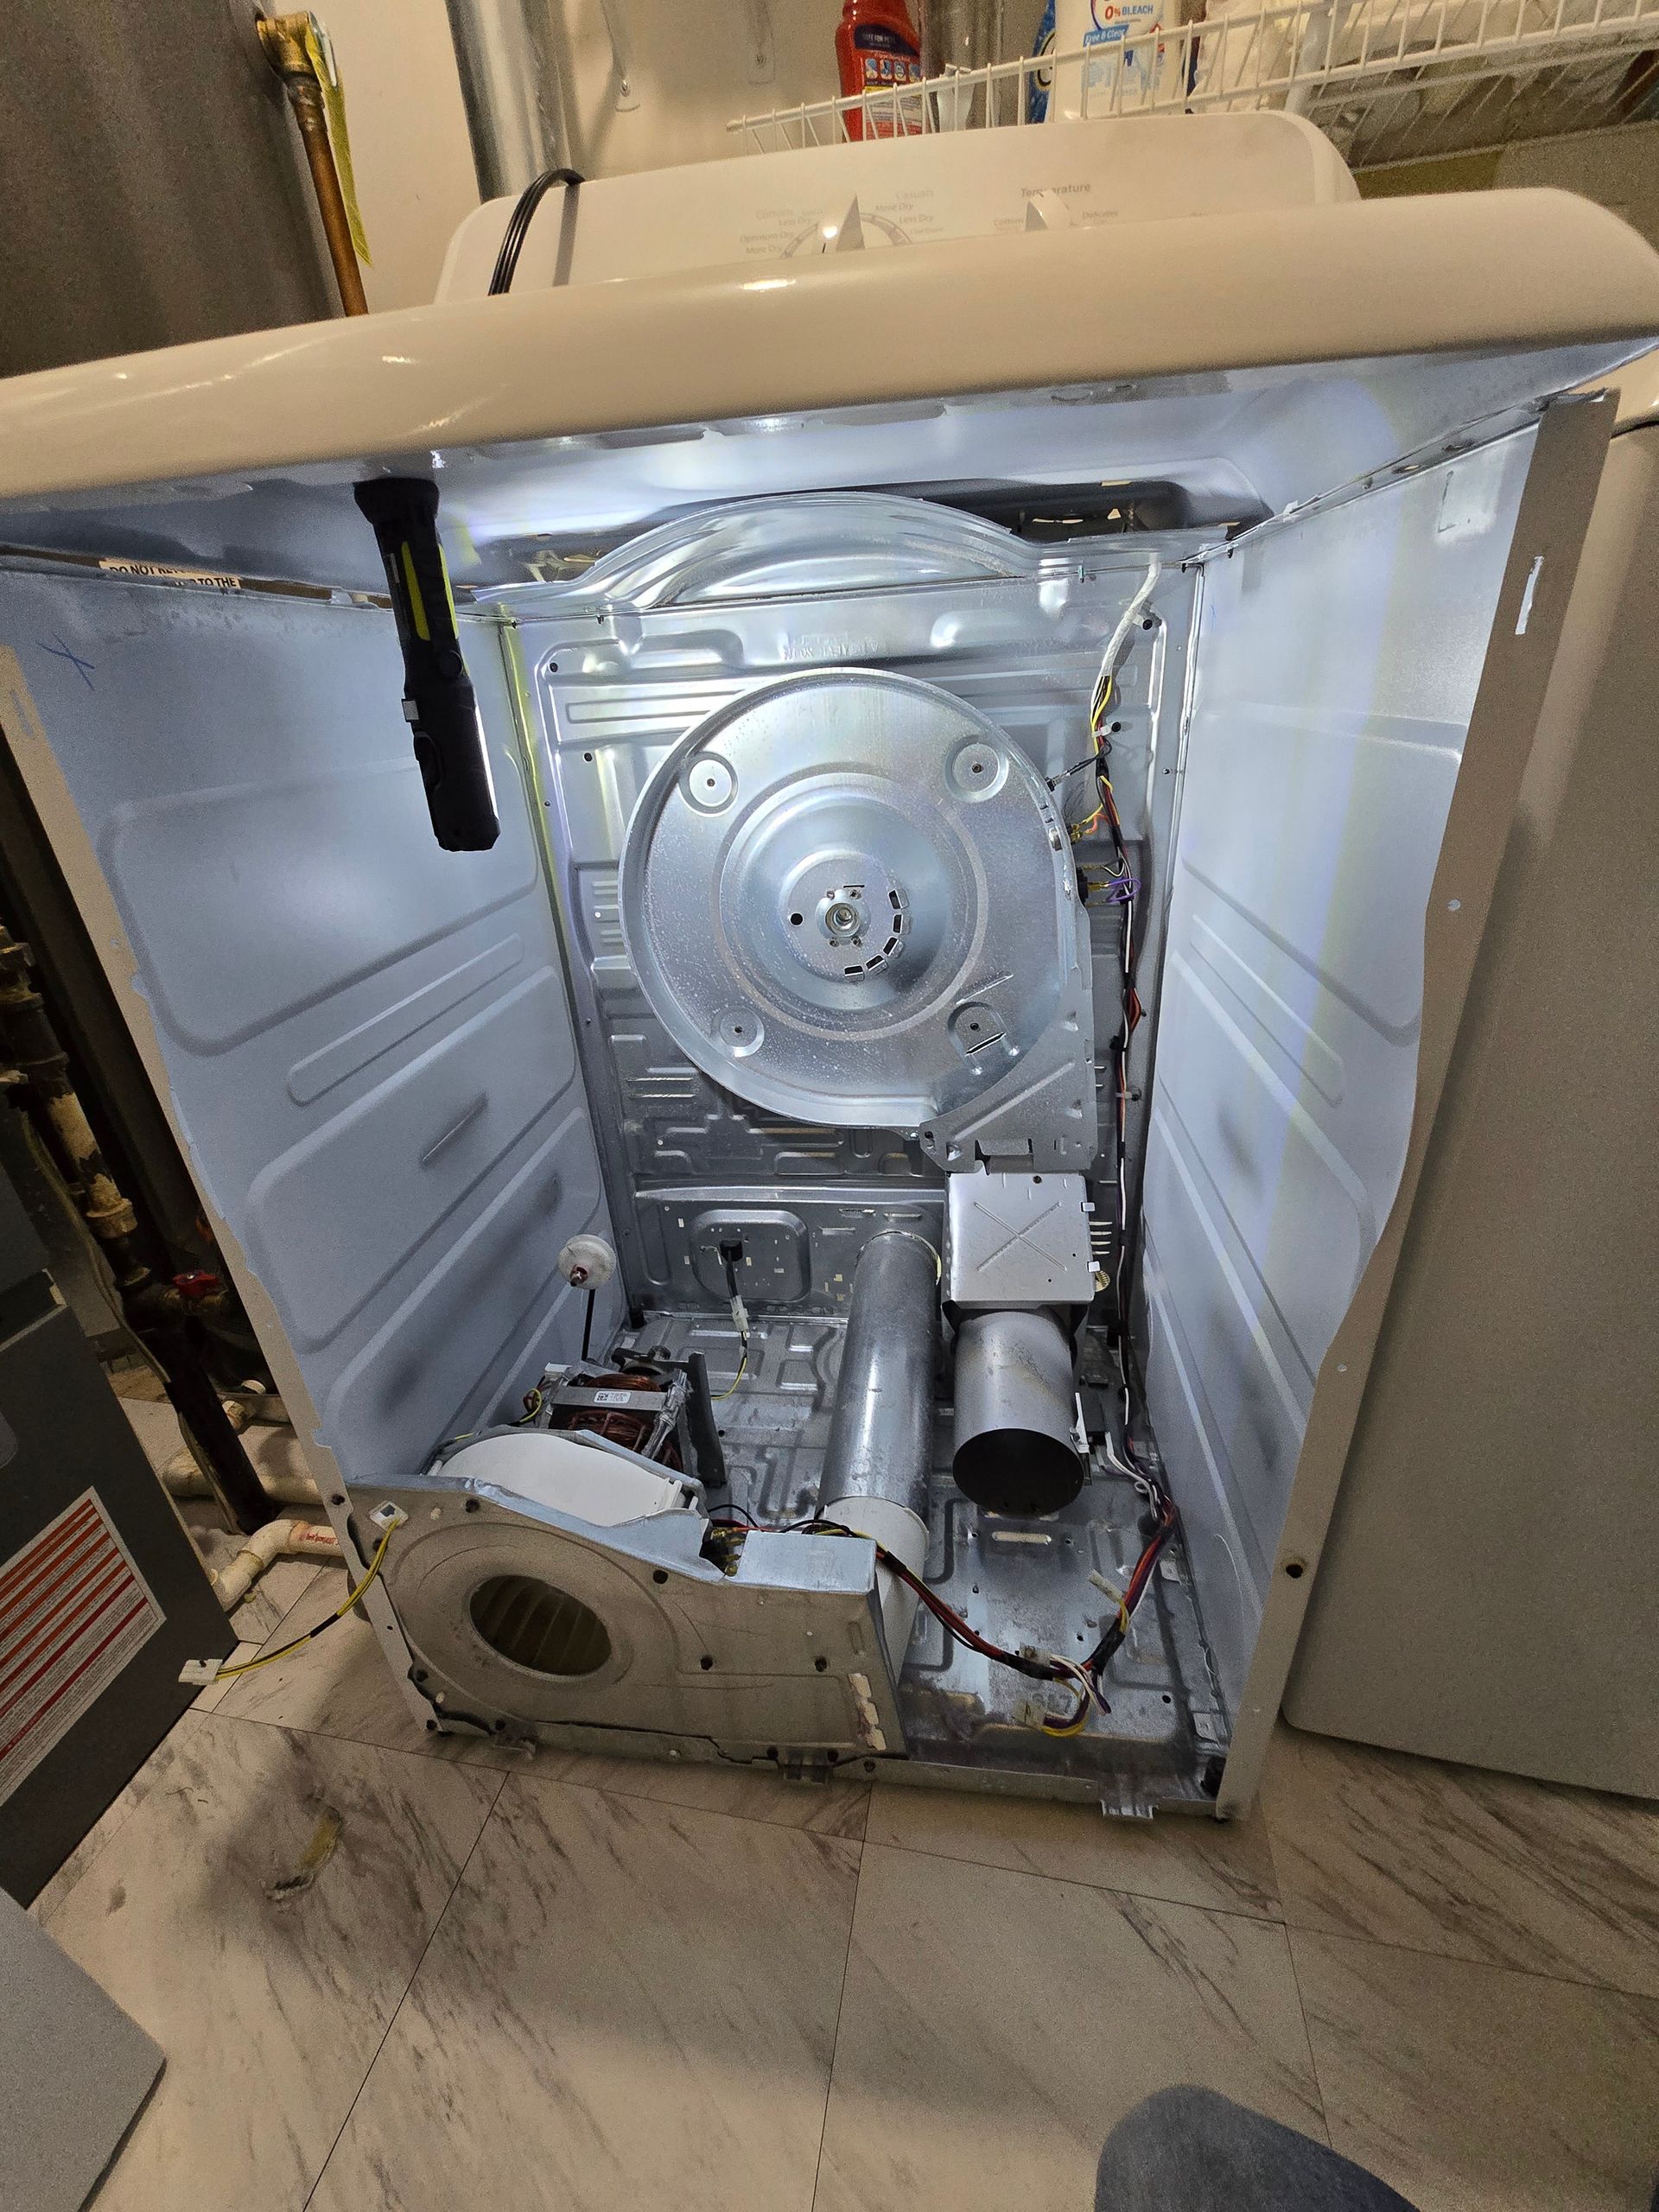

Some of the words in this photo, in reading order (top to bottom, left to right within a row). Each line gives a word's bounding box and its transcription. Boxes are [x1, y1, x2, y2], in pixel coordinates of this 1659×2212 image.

[1122, 5, 1154, 16] BLEACH
[874, 203, 897, 213] More
[899, 201, 914, 212] Dry
[899, 214, 918, 224] Less
[918, 213, 934, 224] Dry
[746, 245, 768, 255] More
[199, 576, 214, 587] TO
[213, 576, 238, 588] THE
